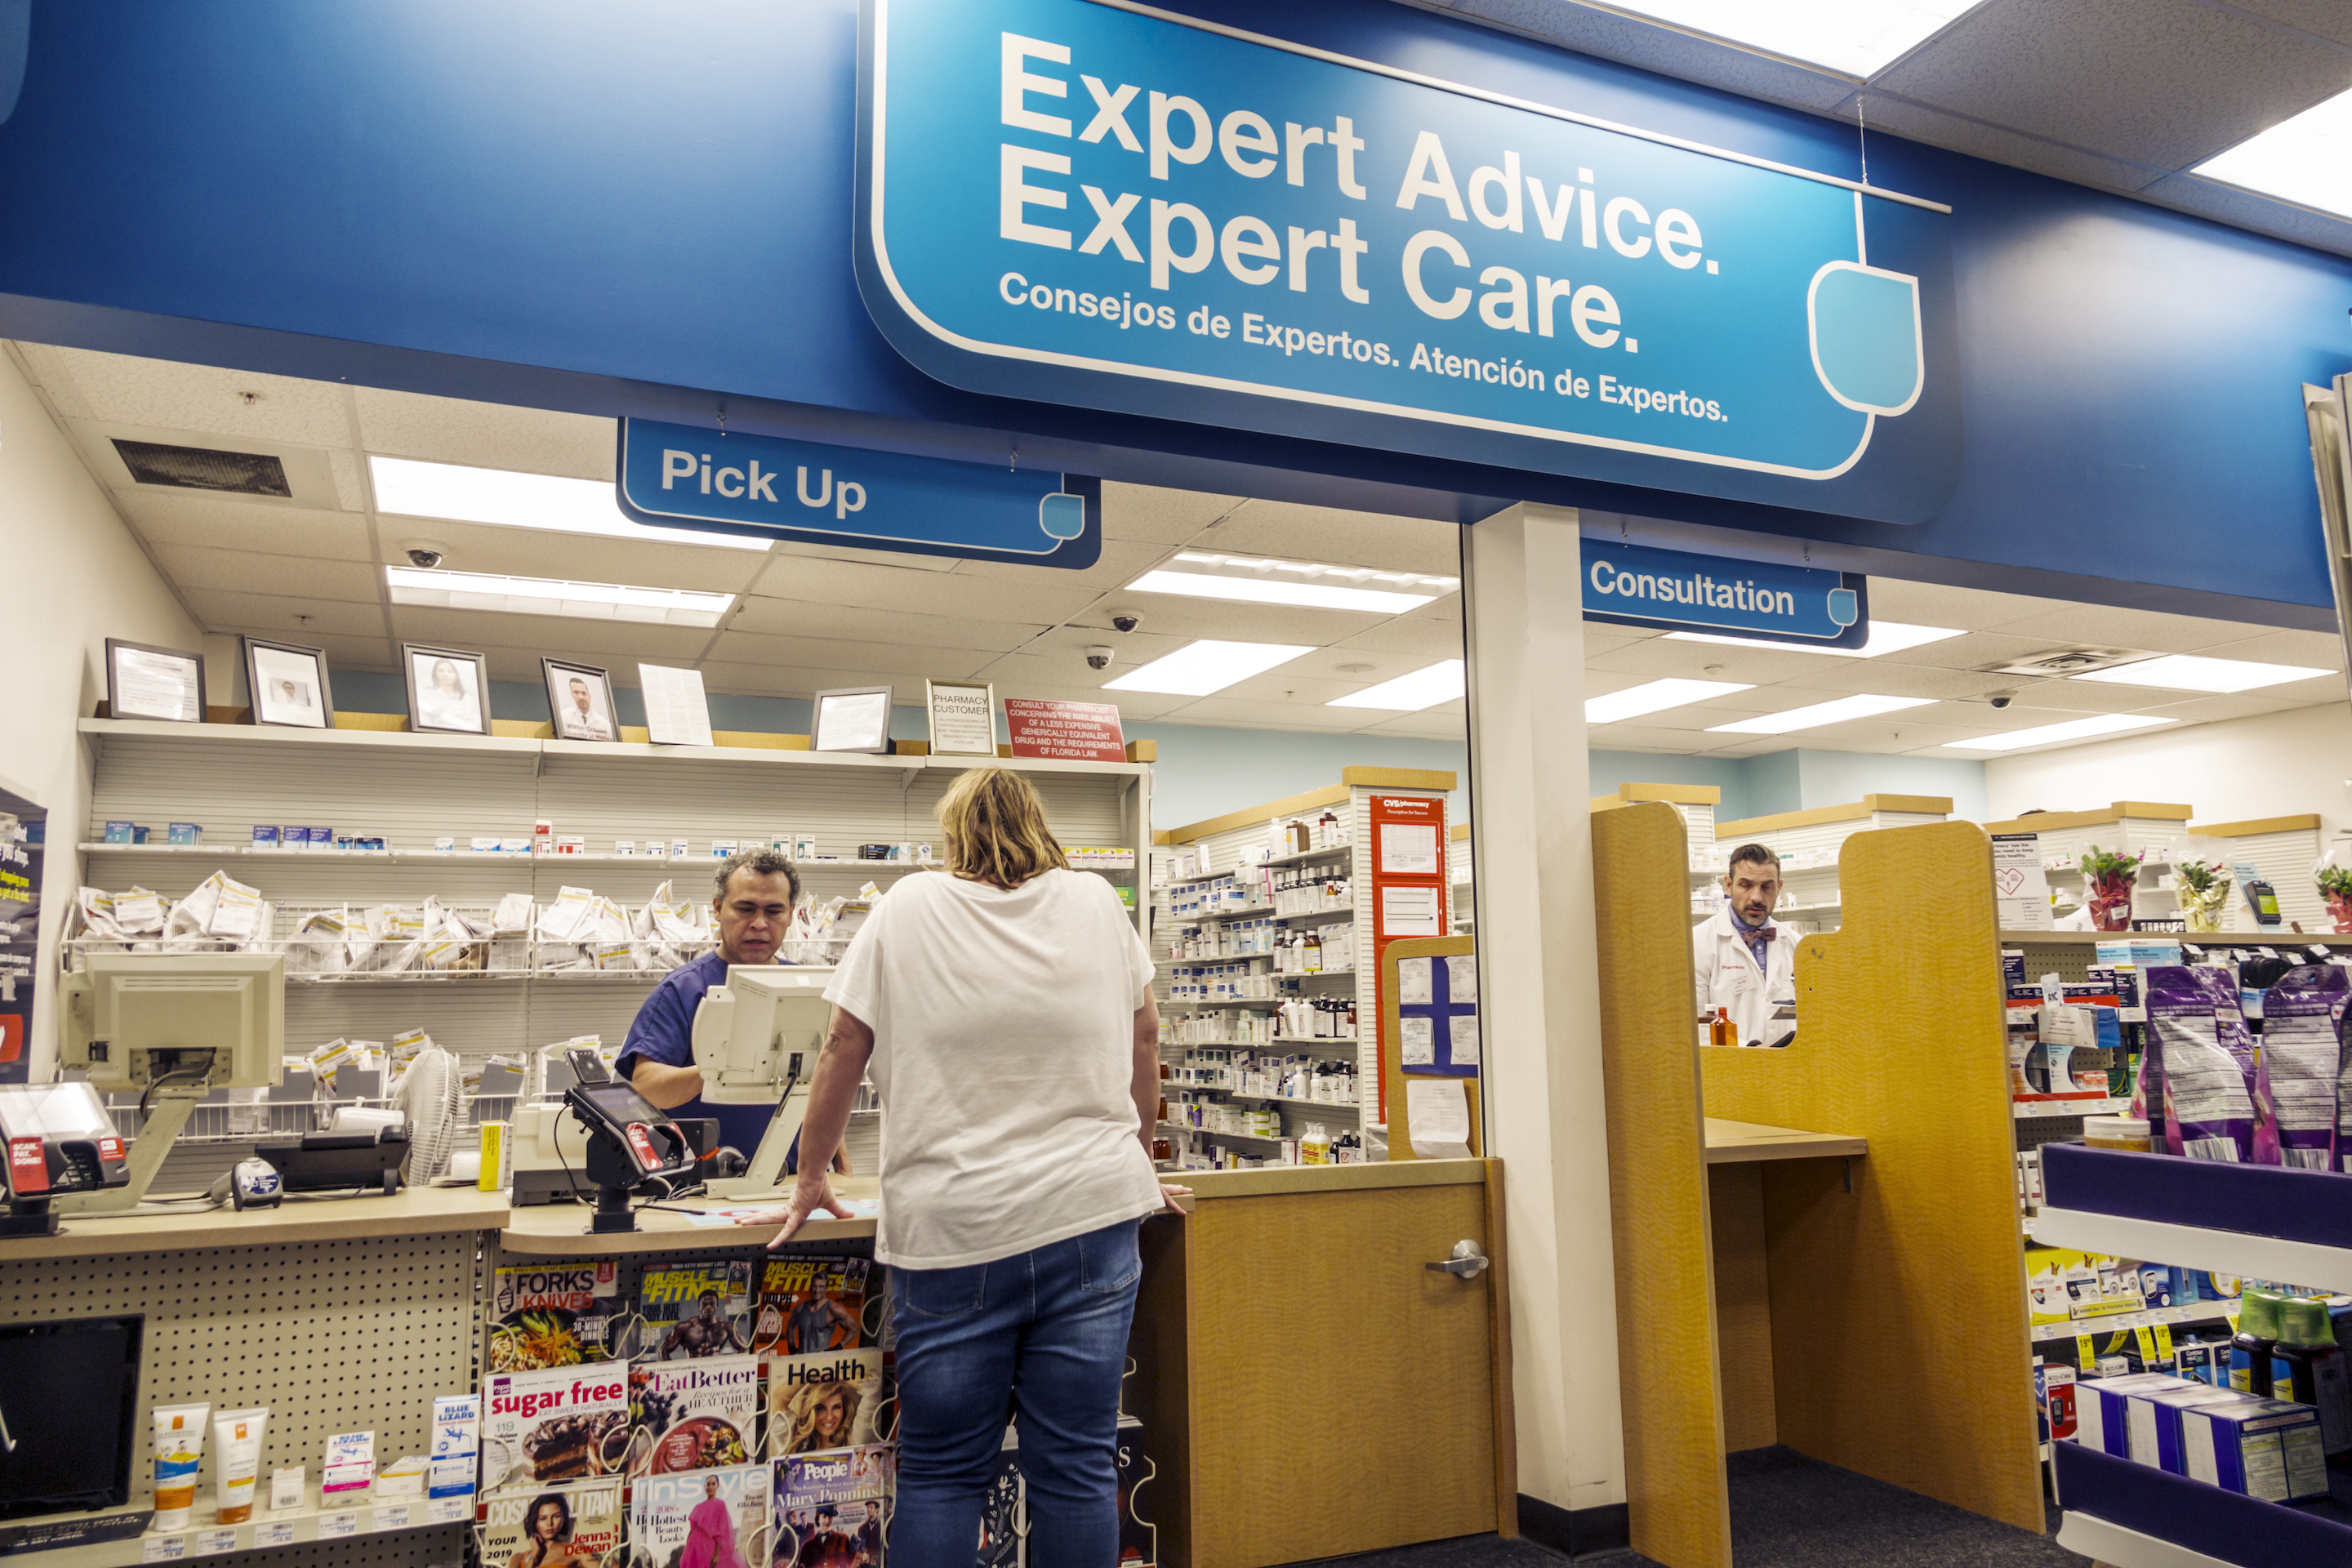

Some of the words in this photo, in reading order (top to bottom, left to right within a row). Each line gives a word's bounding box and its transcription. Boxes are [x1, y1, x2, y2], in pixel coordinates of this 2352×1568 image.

[1000, 31, 1366, 201] Expert
[1396, 131, 1720, 274] Advice.
[1000, 144, 1369, 305] Expert
[1401, 229, 1638, 354] Care.
[998, 271, 1178, 331] Consejos
[1187, 305, 1232, 339] de
[1242, 314, 1400, 368] Expertos.
[1409, 342, 1546, 392] Atención
[1553, 365, 1592, 399] de
[1598, 373, 1729, 424] Expertos.
[662, 448, 778, 503] Pick
[796, 466, 867, 519] Up
[1590, 559, 1795, 617] Consultation
[933, 694, 988, 705] PHARMACY
[933, 705, 989, 715] CUSTOMER
[1012, 700, 1045, 709] CONSULT
[1045, 702, 1066, 710] YOUR
[1066, 704, 1109, 714] PHARMACIST
[1009, 709, 1057, 719] CONCERNING
[1058, 711, 1072, 719] THE
[1072, 713, 1115, 723] AVAILABILITY
[1065, 721, 1102, 731] EXPENSIVE
[1021, 728, 1067, 737] GENERICALLY
[1069, 730, 1110, 740] EQUIVALENT
[1014, 736, 1036, 745] DRUG
[1036, 737, 1051, 746] AND
[1052, 738, 1067, 746] THE
[1067, 739, 1120, 750] REQUIREMENTS
[1040, 746, 1050, 755] OF
[1051, 747, 1080, 756] FLORIDA
[1082, 749, 1098, 758] LAW.
[1383, 799, 1430, 808] CVS/pharmacy
[14, 1156, 42, 1165] DONE!
[766, 1262, 828, 1274] MUSCLE
[2066, 1270, 2088, 1279] FreeStyle
[516, 1269, 595, 1295] FORKS
[644, 1270, 709, 1285] MUSCLE
[769, 1274, 844, 1291] FITES
[2033, 1278, 2055, 1286] FreeStyle
[642, 1285, 652, 1294] &
[648, 1280, 728, 1303] FITNES
[2186, 1348, 2203, 1356] Contour
[788, 1358, 865, 1386] Health
[492, 1390, 565, 1419] sugar
[571, 1380, 623, 1405] free
[689, 1393, 753, 1409] HEALTHIER
[693, 1389, 727, 1401] Recipes
[728, 1387, 743, 1396] for
[444, 1404, 470, 1413] BLUE
[555, 1407, 578, 1415] SWEET
[581, 1399, 623, 1411] NATURALLY
[725, 1403, 751, 1414] YOU!
[804, 1461, 848, 1481] People
[648, 1468, 768, 1501] InSyle
[777, 1493, 817, 1508] Mary
[820, 1486, 879, 1503] Poppins
[488, 1490, 615, 1527] COSMLITAN
[651, 1513, 687, 1526] Hottest
[656, 1525, 684, 1535] Beauty
[488, 1536, 518, 1547] YOUR
[571, 1530, 611, 1545] Jenna
[659, 1533, 685, 1544] Looks
[487, 1549, 513, 1560] 2019
[564, 1540, 611, 1557] Dewan
